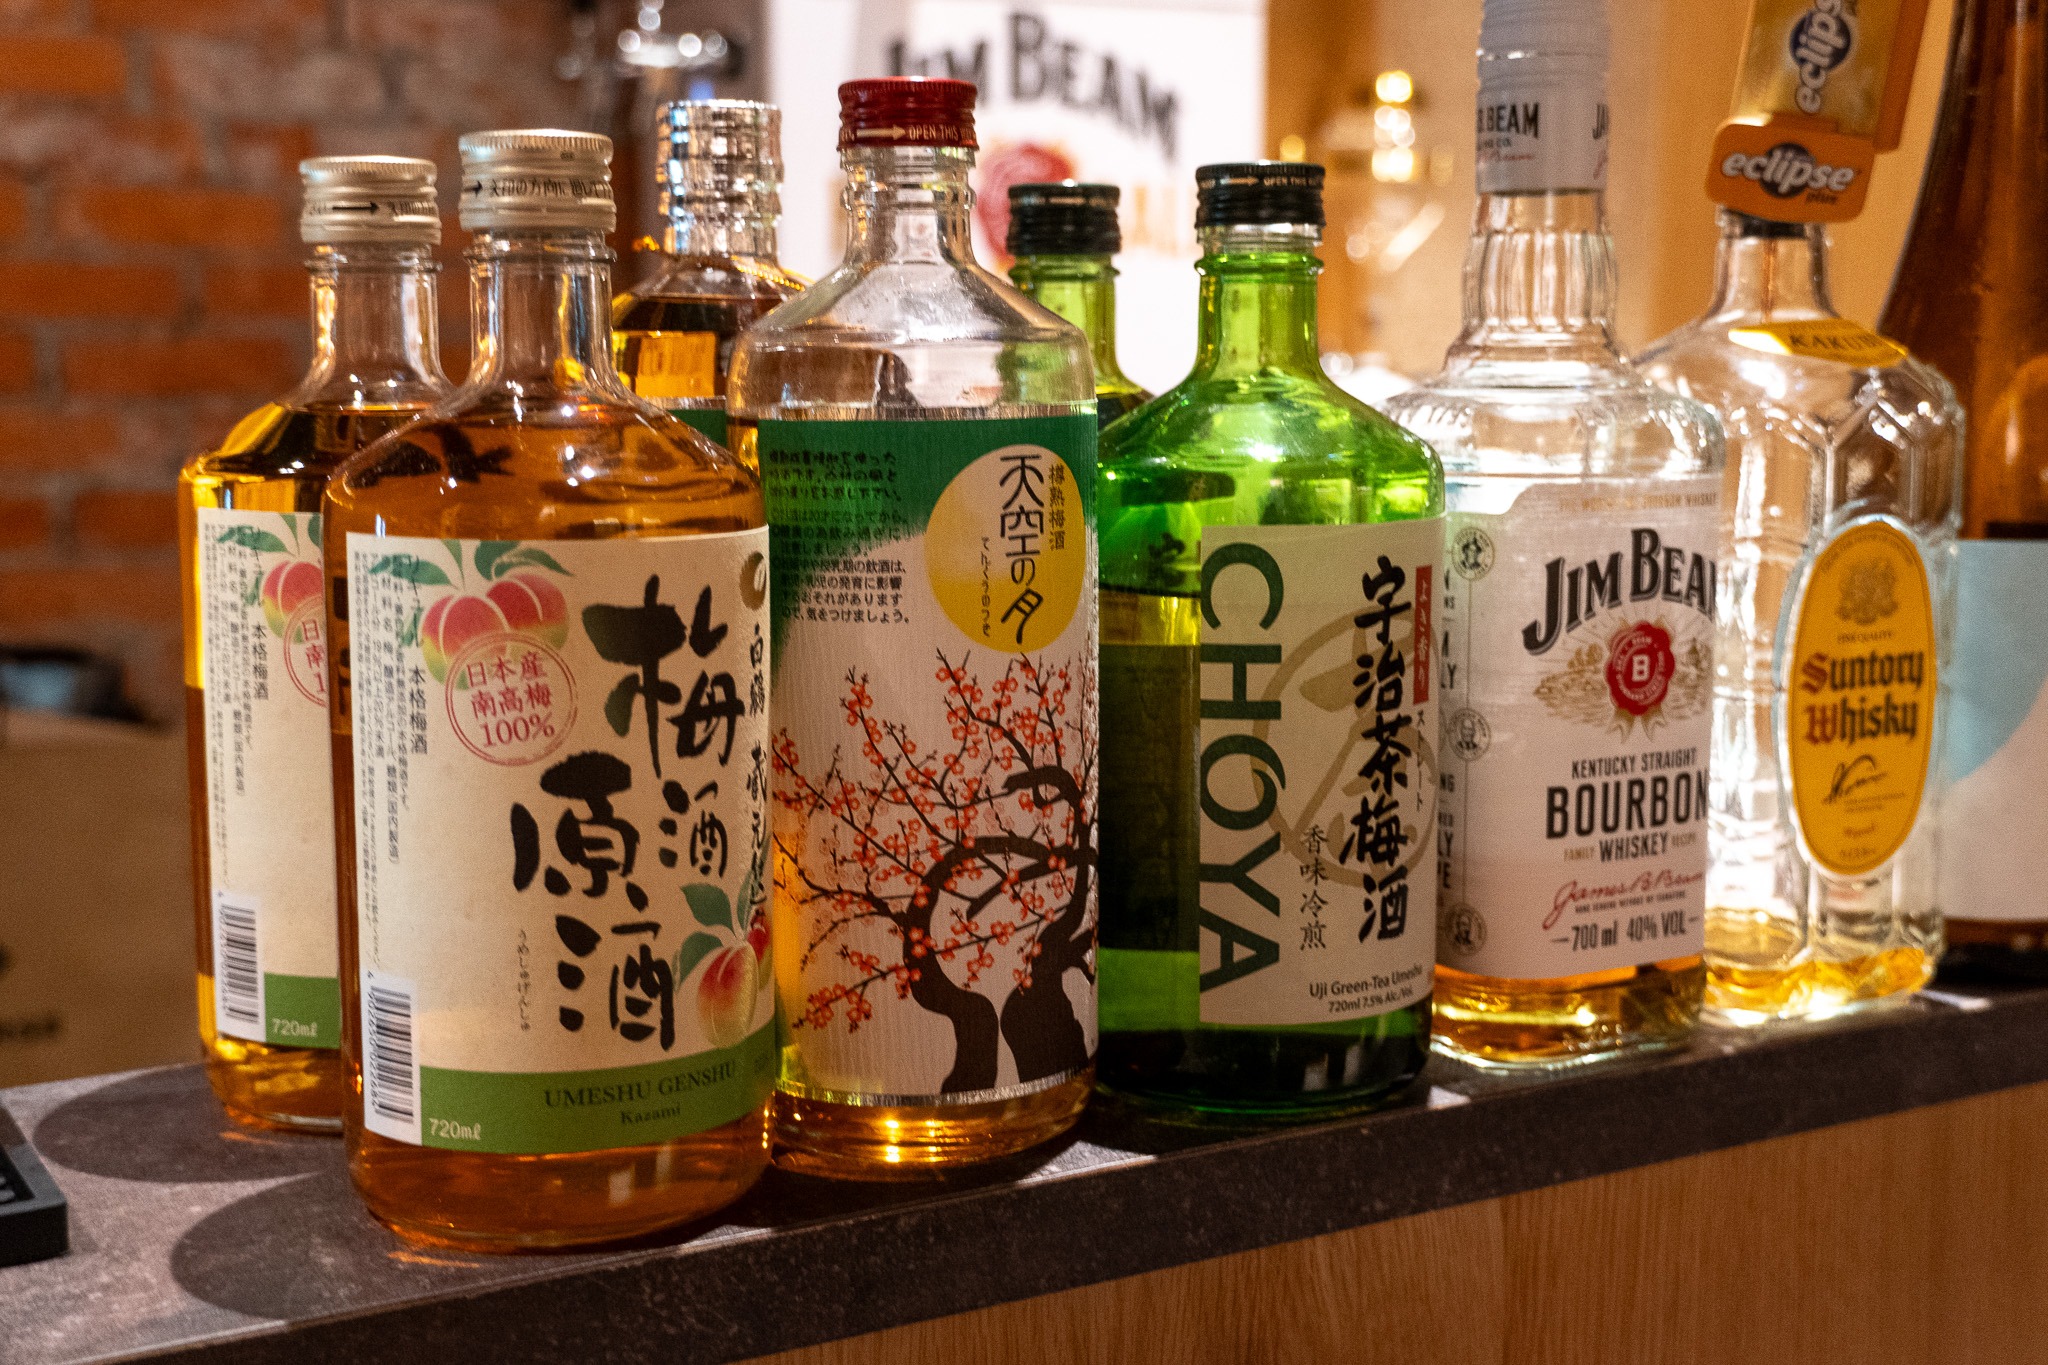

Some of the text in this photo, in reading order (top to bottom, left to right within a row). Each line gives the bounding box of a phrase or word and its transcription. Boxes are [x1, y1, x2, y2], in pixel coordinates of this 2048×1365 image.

[908, 124, 937, 141] OPEN
[1722, 146, 1854, 194] eclipse
[999, 454, 1045, 645] 天空の月
[1522, 551, 1623, 656] JIM
[466, 651, 548, 686] 日本産
[1632, 653, 1650, 682] B
[1801, 650, 1924, 696] Suntory
[471, 683, 553, 718] 南高梅
[478, 712, 557, 748] 100%
[1805, 693, 1918, 746] Whisky
[1339, 555, 1412, 943] 宇治茶梅酒
[1572, 747, 1698, 780] KENTUCKY STRAIGHT
[1200, 542, 1285, 993] CHOYA
[1599, 832, 1668, 863] WHISKEY
[1300, 824, 1329, 950] 香味冷煎
[1626, 914, 1658, 941] 40%
[1661, 910, 1686, 937] VOL
[1309, 982, 1328, 1001] Uji
[1331, 974, 1390, 996] Green-Tea
[1328, 998, 1361, 1013] 720ml
[544, 1060, 737, 1109] UMESHU GENSHU
[620, 1103, 681, 1126] Kazami
